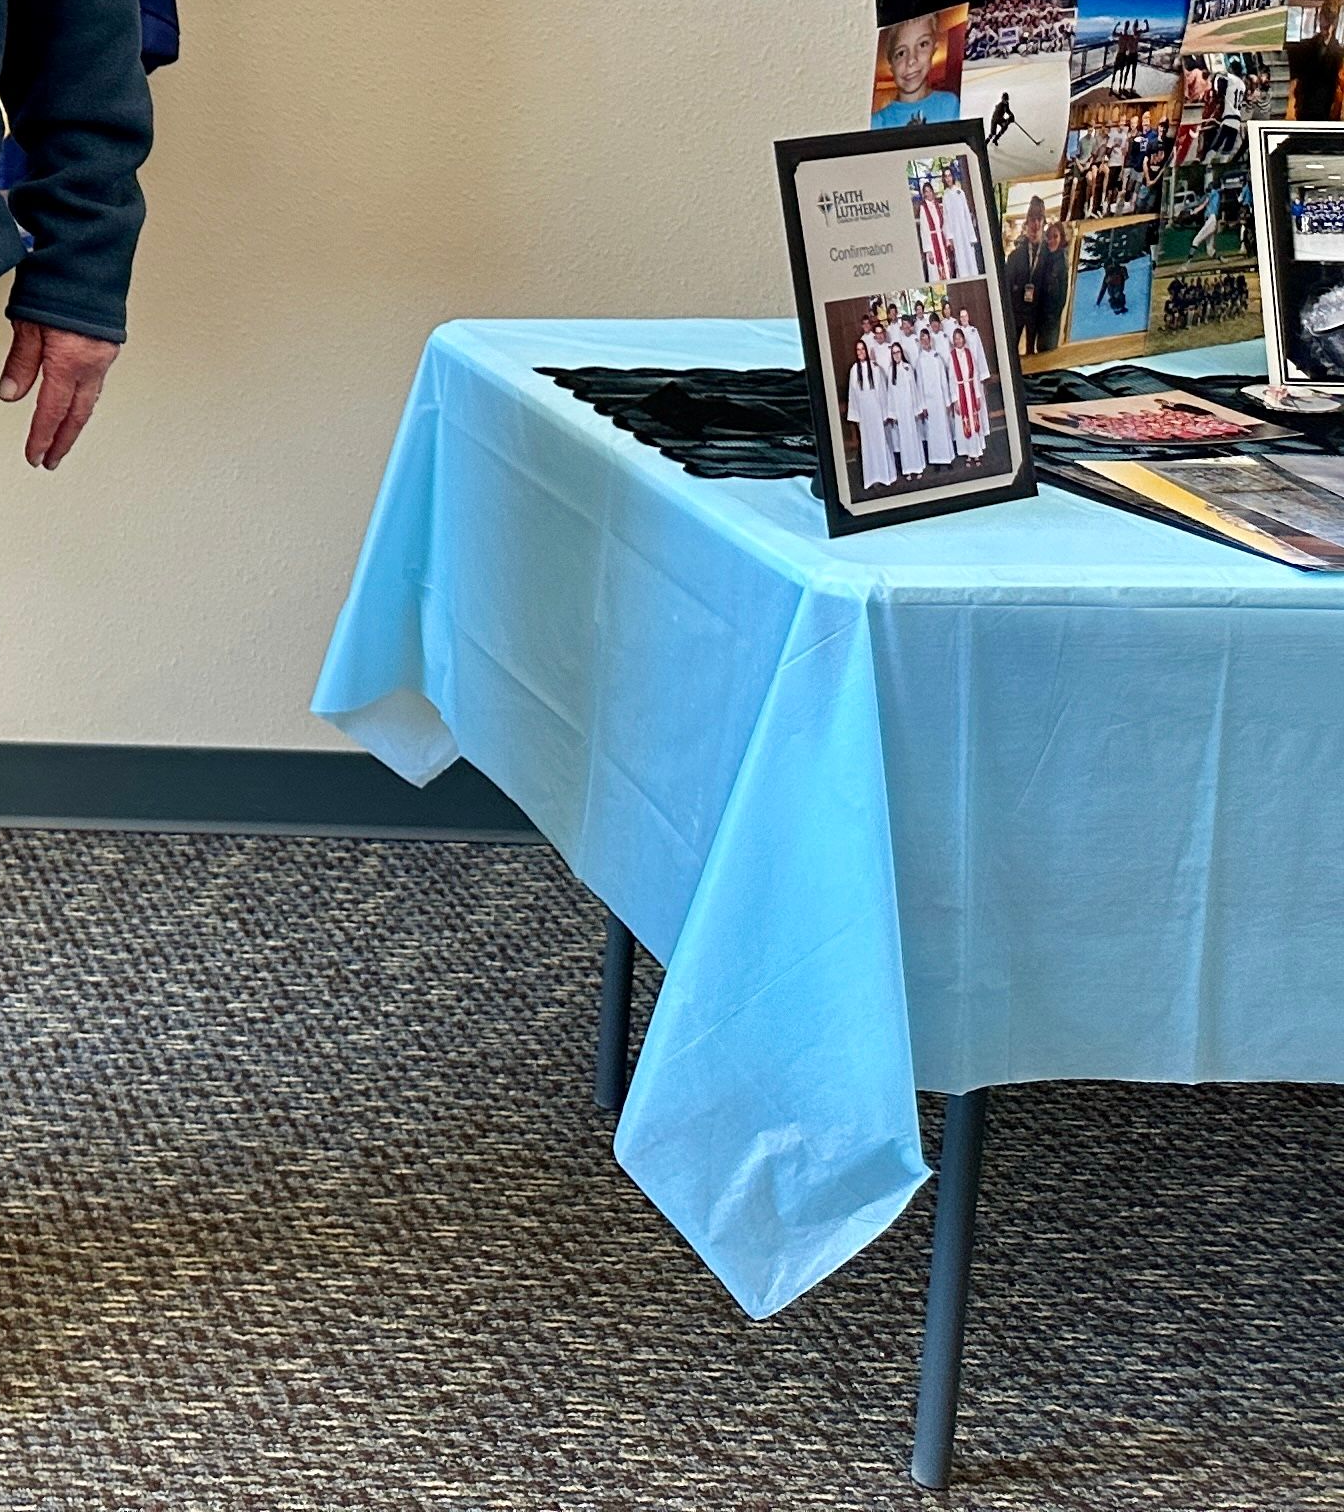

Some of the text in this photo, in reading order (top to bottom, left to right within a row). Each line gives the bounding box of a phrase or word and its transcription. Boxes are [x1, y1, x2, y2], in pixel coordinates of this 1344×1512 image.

[832, 190, 864, 205] FAITH
[834, 200, 890, 219] LUTHERAN
[829, 243, 894, 262] Confirmation
[853, 262, 876, 278] 2021
